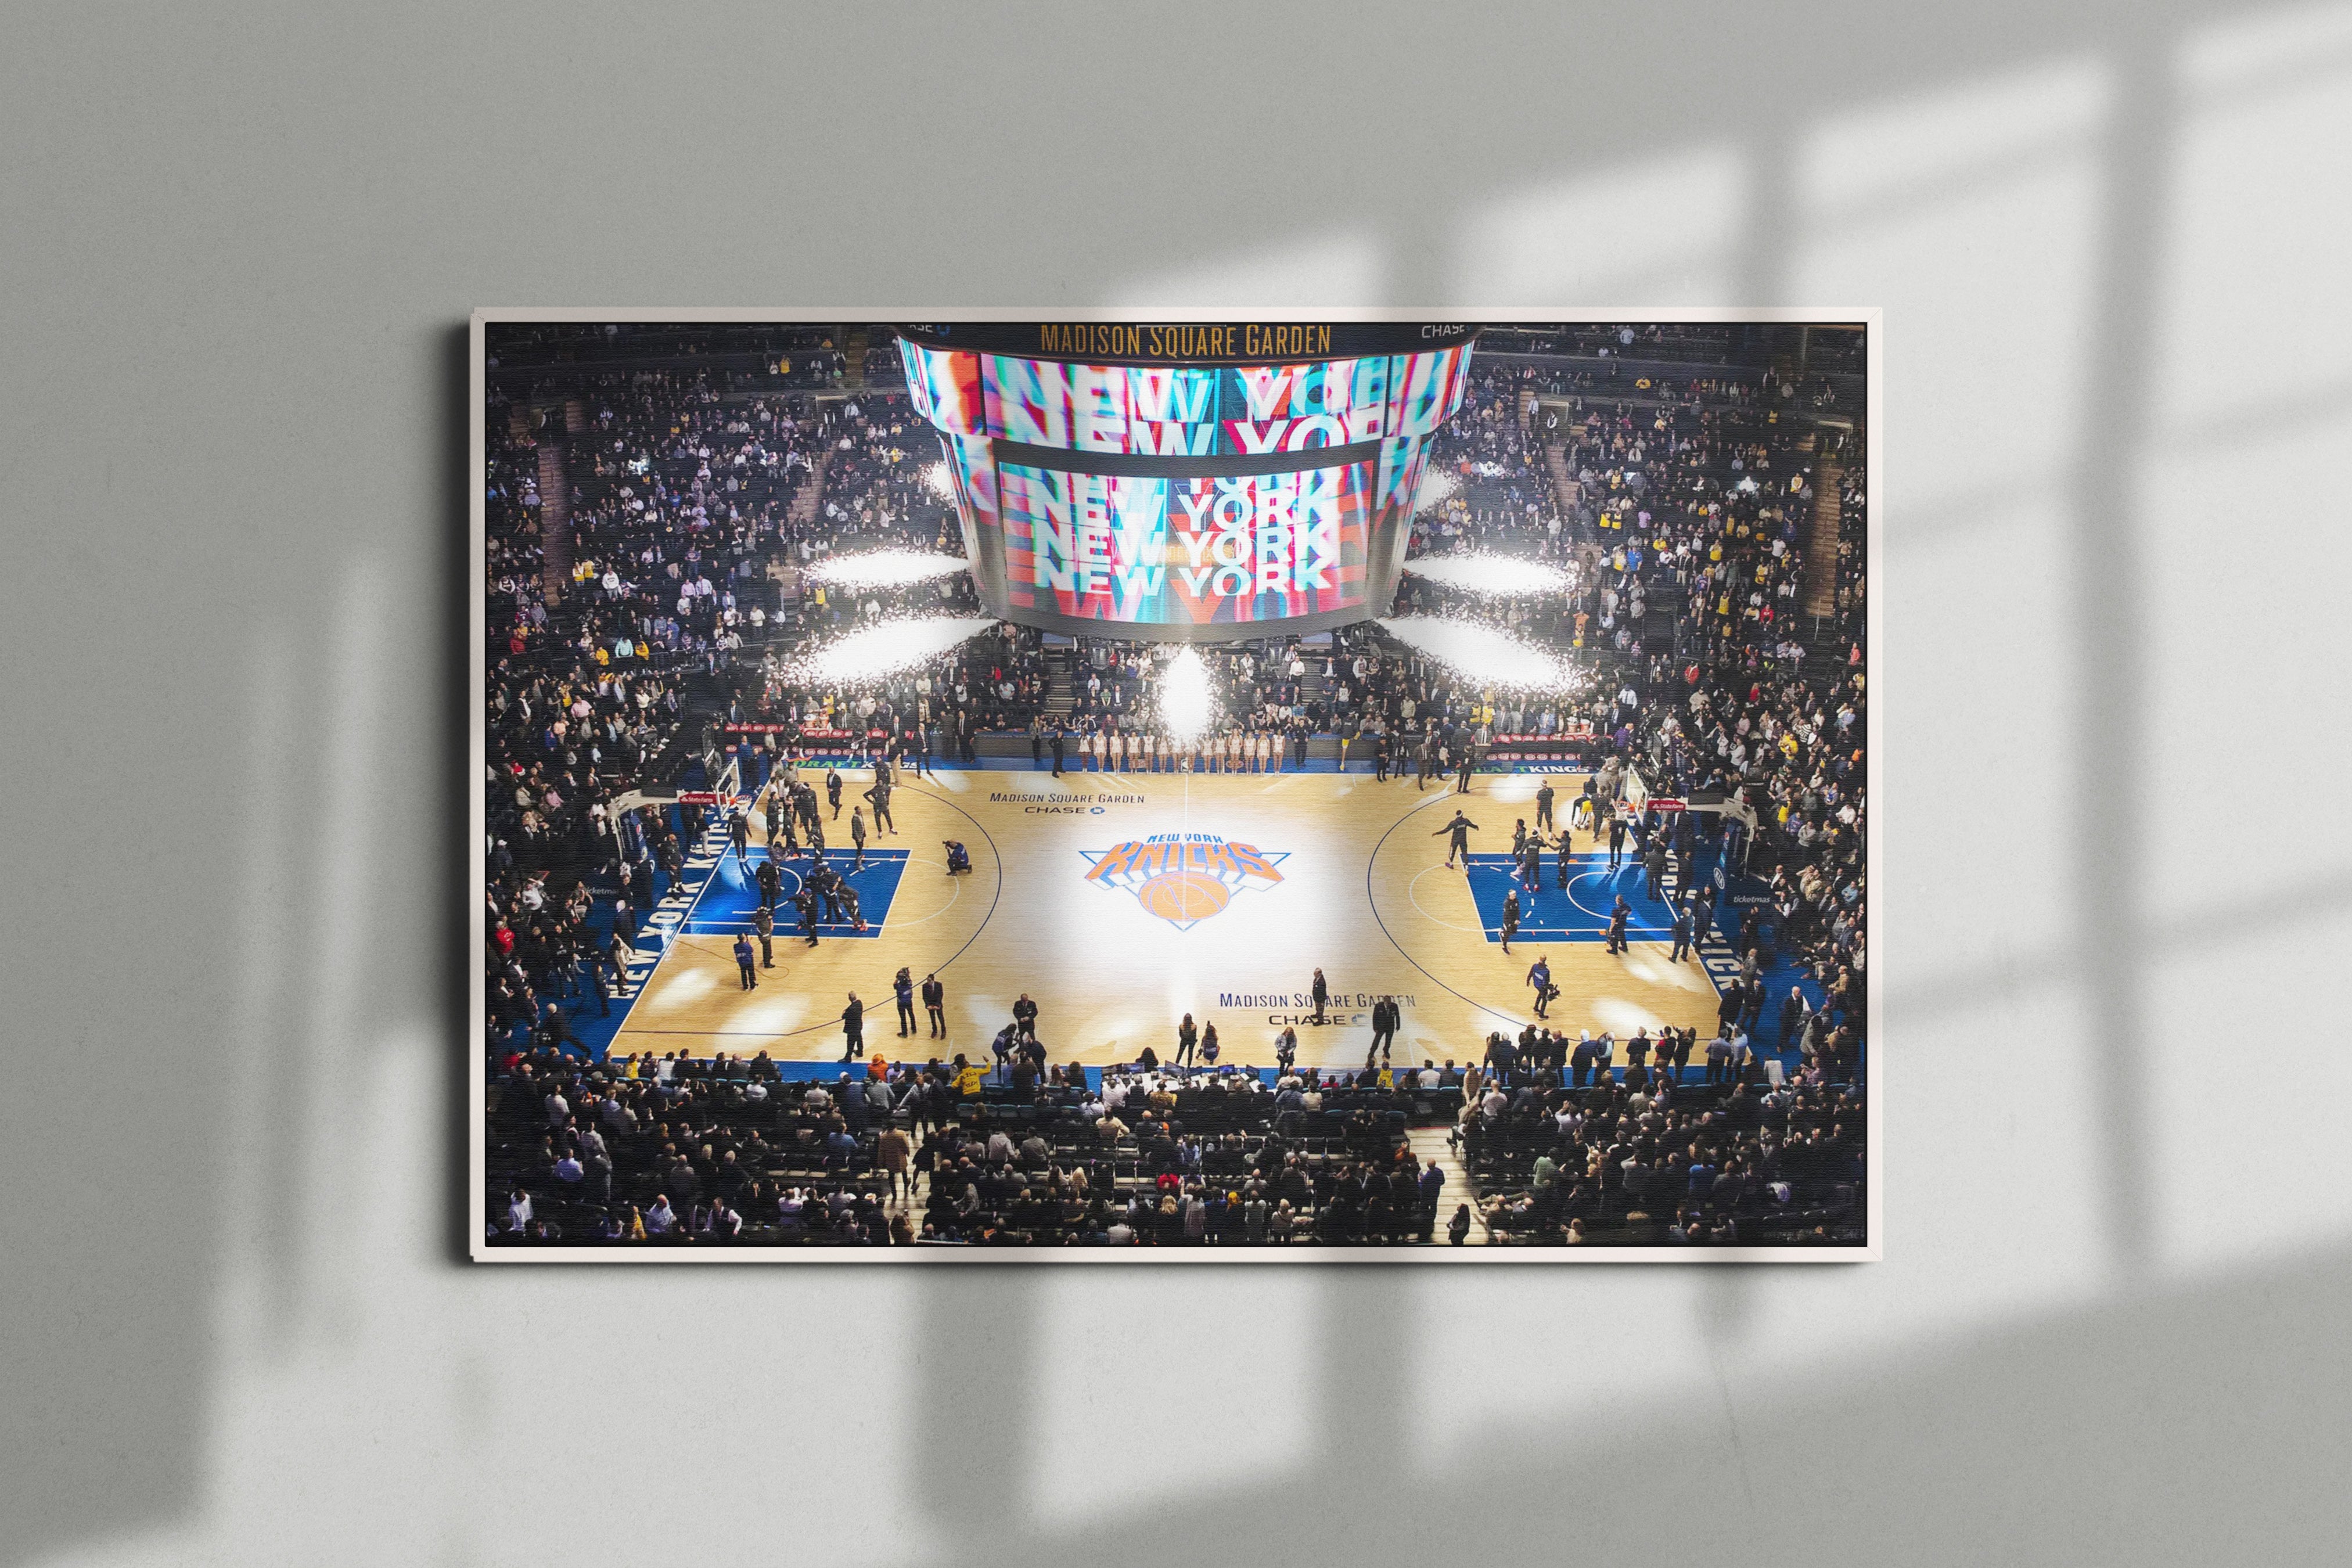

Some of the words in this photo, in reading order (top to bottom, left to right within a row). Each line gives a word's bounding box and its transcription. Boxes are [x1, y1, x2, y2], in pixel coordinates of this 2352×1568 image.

[1041, 325, 1140, 355] MADISON
[1149, 325, 1236, 358] SQUARE
[1246, 325, 1330, 356] GARDEN
[1422, 325, 1465, 338] CHASE
[1179, 521, 1337, 567] YORK
[1178, 558, 1332, 598] YORK
[990, 793, 1044, 803] MADISON
[1048, 793, 1094, 803] SQUARE
[1099, 794, 1145, 803] GARDEN
[1147, 834, 1180, 843] NEW
[1185, 833, 1223, 844] YORK
[1084, 840, 1285, 884] KNICKS
[1220, 993, 1288, 1008] MADISON
[1294, 993, 1352, 1009] SQARE
